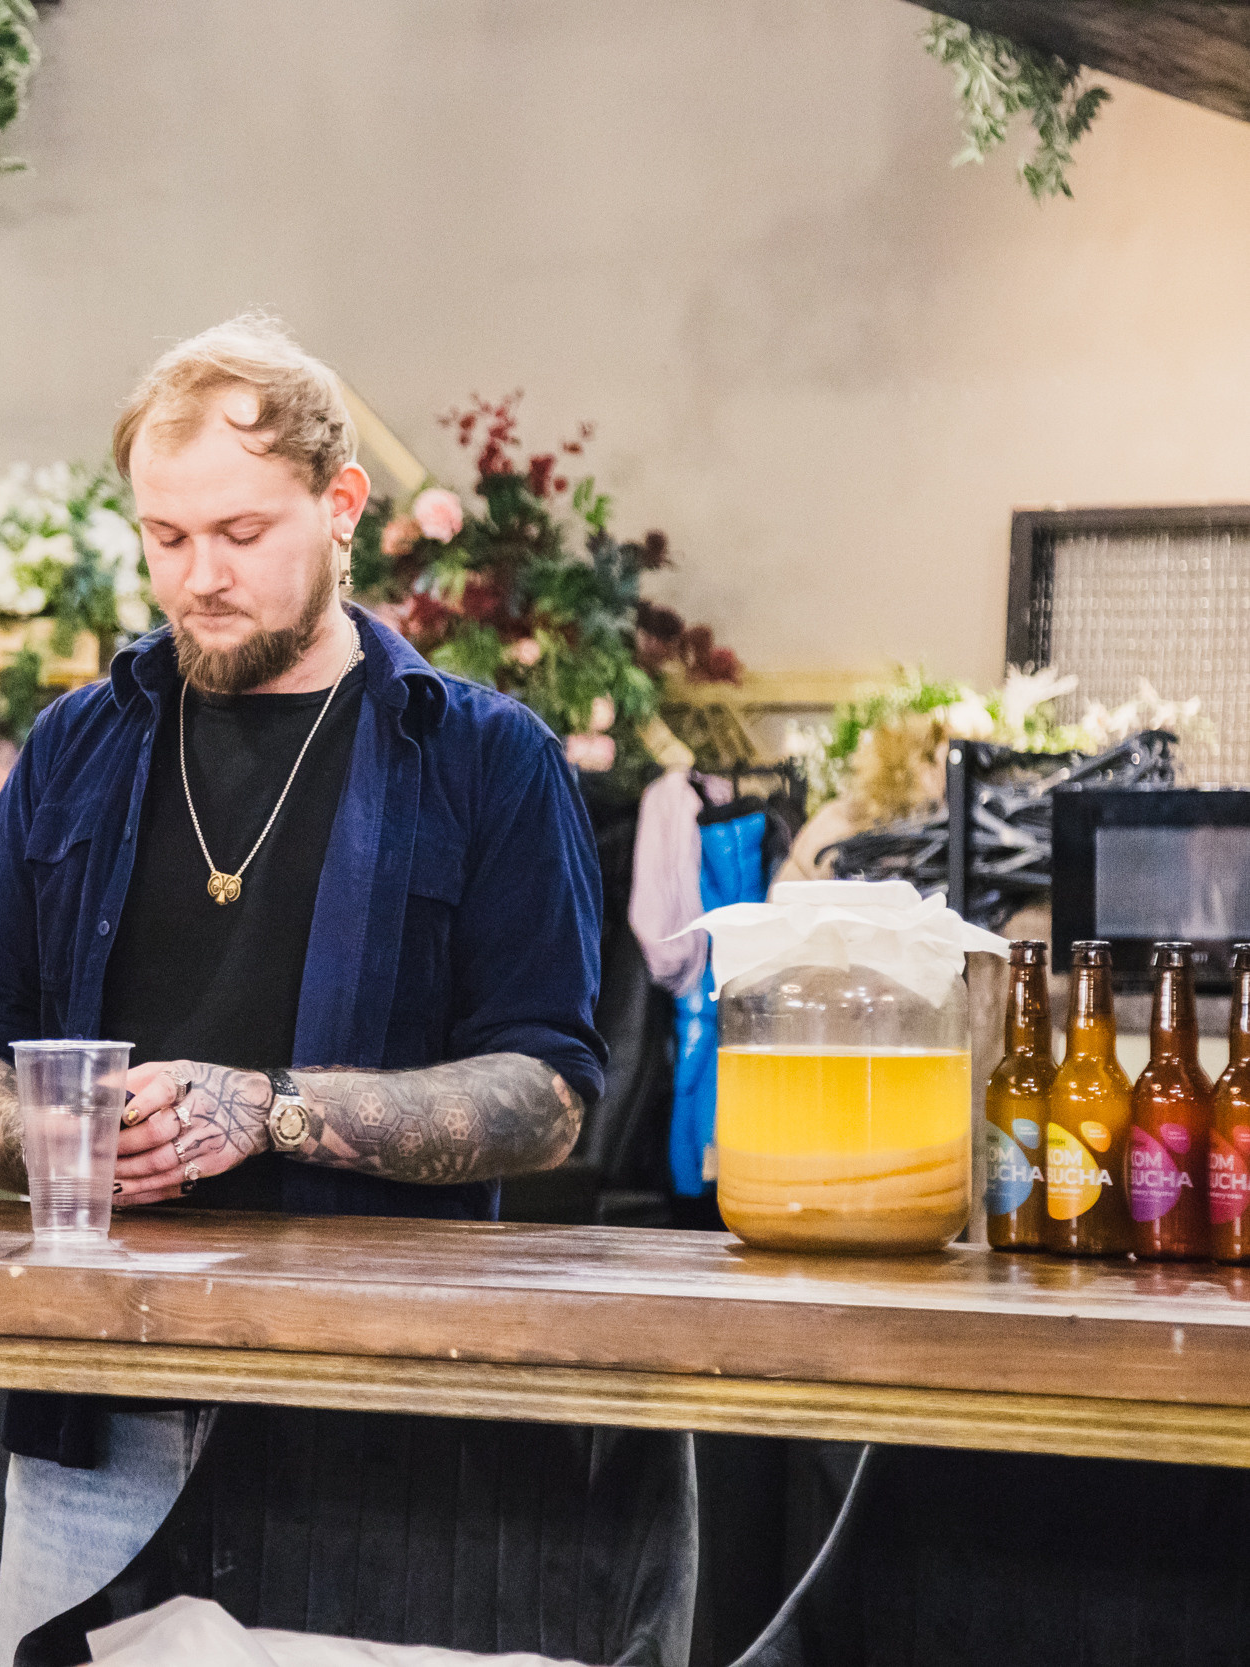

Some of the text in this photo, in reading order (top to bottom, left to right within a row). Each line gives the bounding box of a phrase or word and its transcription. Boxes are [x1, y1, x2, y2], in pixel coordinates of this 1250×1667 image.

[989, 1146, 1016, 1164] OM
[1210, 1152, 1235, 1171] OM
[989, 1164, 1045, 1183] UCHA
